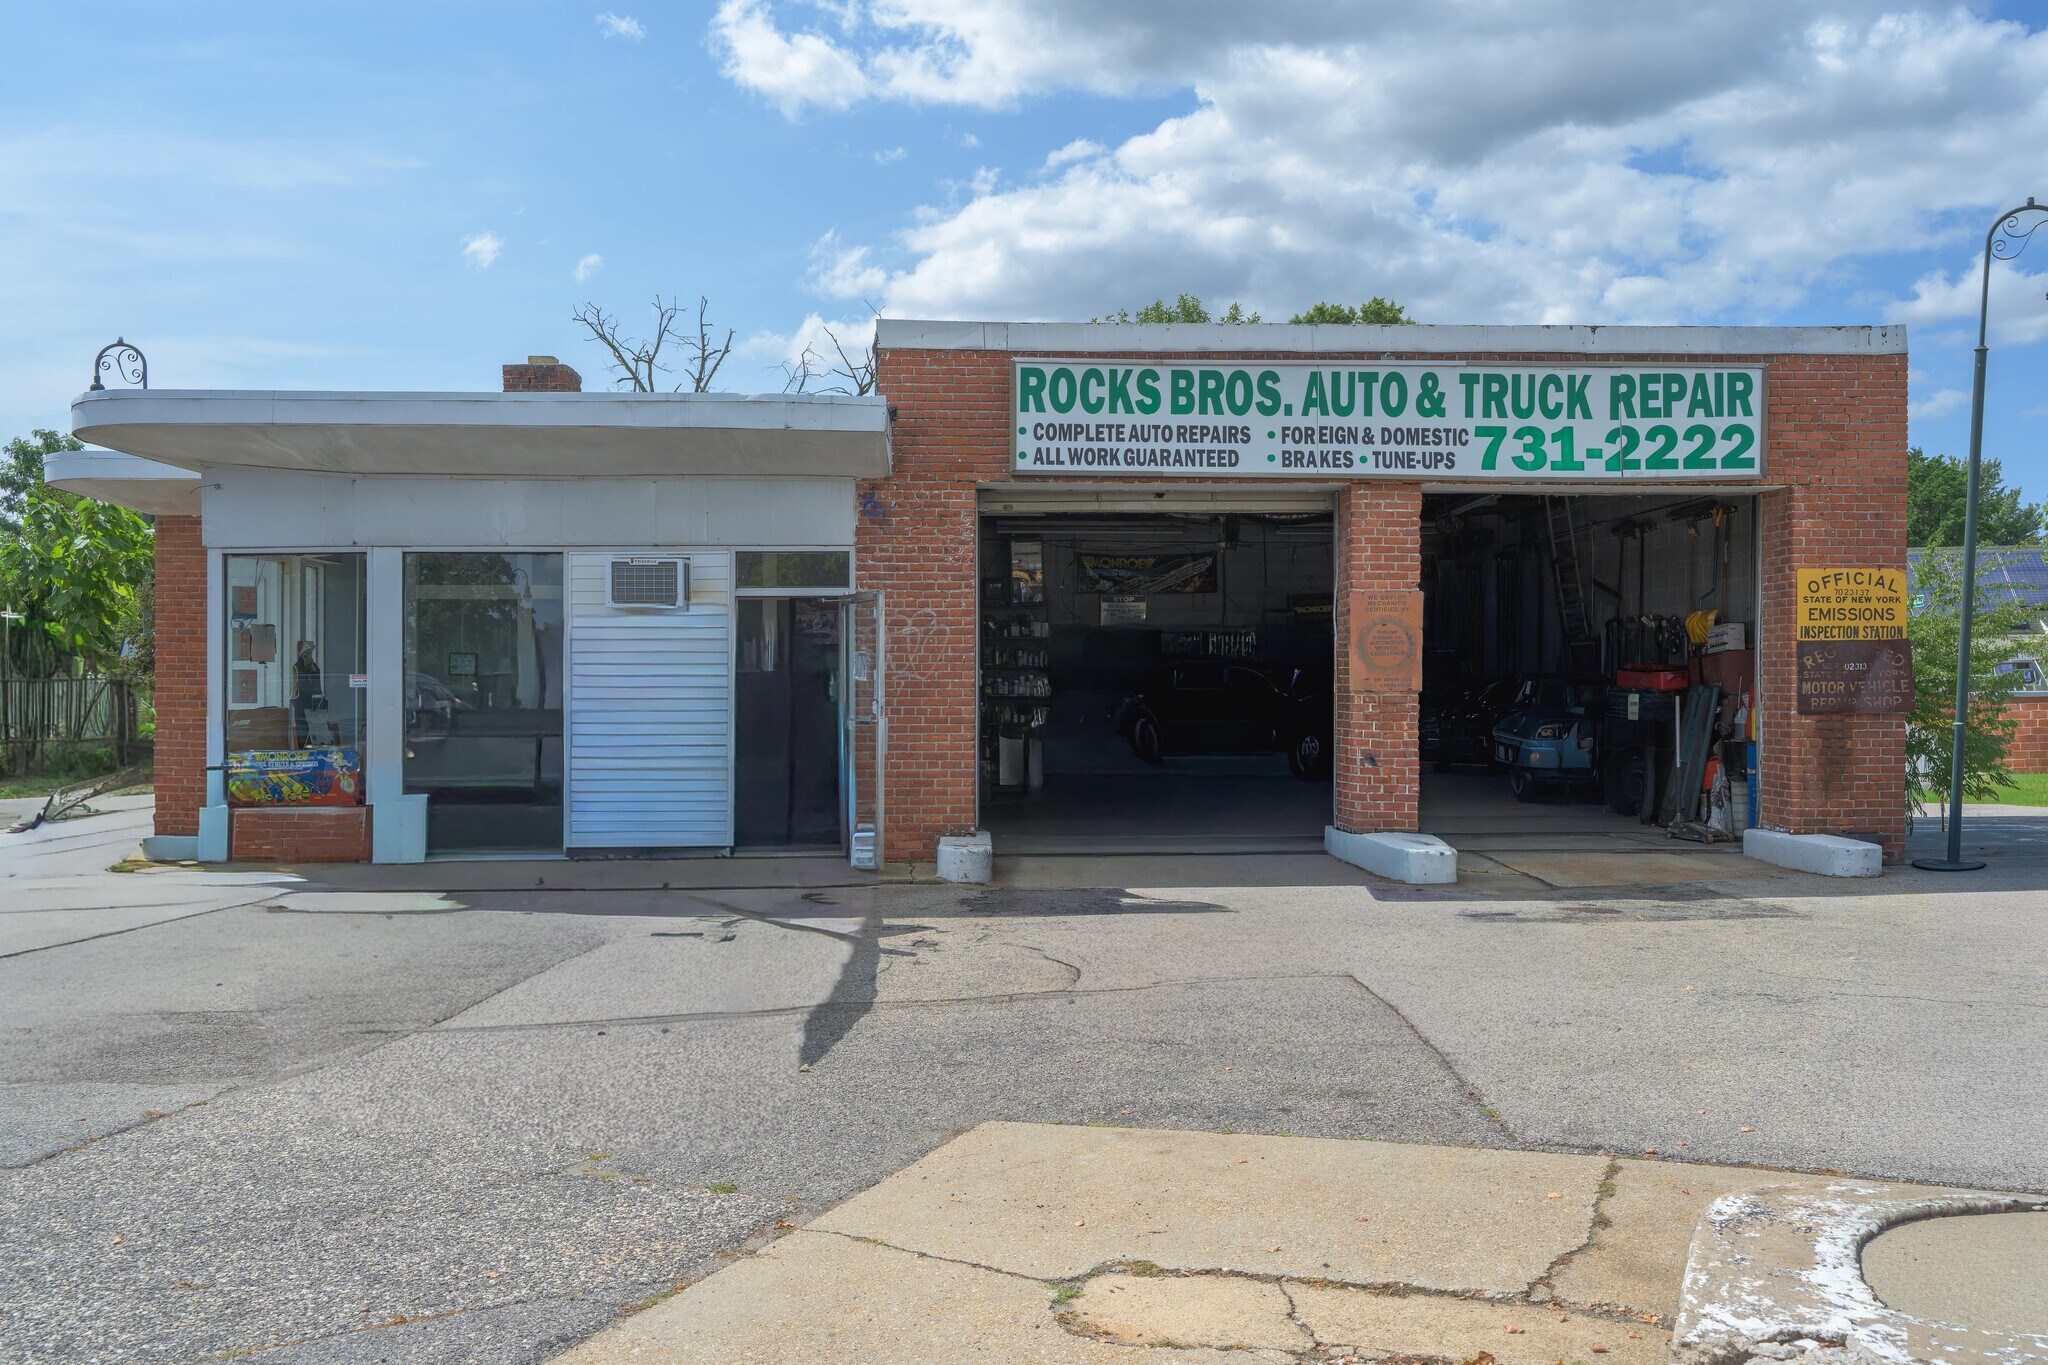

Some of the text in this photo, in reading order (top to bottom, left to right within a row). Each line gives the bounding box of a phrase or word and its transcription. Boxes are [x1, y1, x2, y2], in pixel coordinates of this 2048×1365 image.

[1020, 367, 1754, 420] ROCKS BROS. AUTO & TRUCK REPAIR
[1033, 423, 1251, 444] COMPLETE AUTO REPAIRS
[1281, 426, 1469, 447] FOREIGN & DOMESTIC
[1474, 423, 1755, 472] 731-2222
[1033, 447, 1239, 468] ALL WORK GUARANTEED
[1281, 450, 1354, 469] BRAKES
[1372, 451, 1456, 469] TUNE-UPS
[1091, 556, 1146, 569] MONROE
[1808, 572, 1898, 594] OFFICIAL
[1808, 608, 1896, 621] EMISSIONS
[1800, 626, 1904, 639] INSPECTION STATION
[1802, 682, 1845, 694] MOTOR
[1849, 680, 1910, 694] VEHICLE
[1864, 696, 1902, 708] SHOP
[261, 752, 302, 761] MONROE
